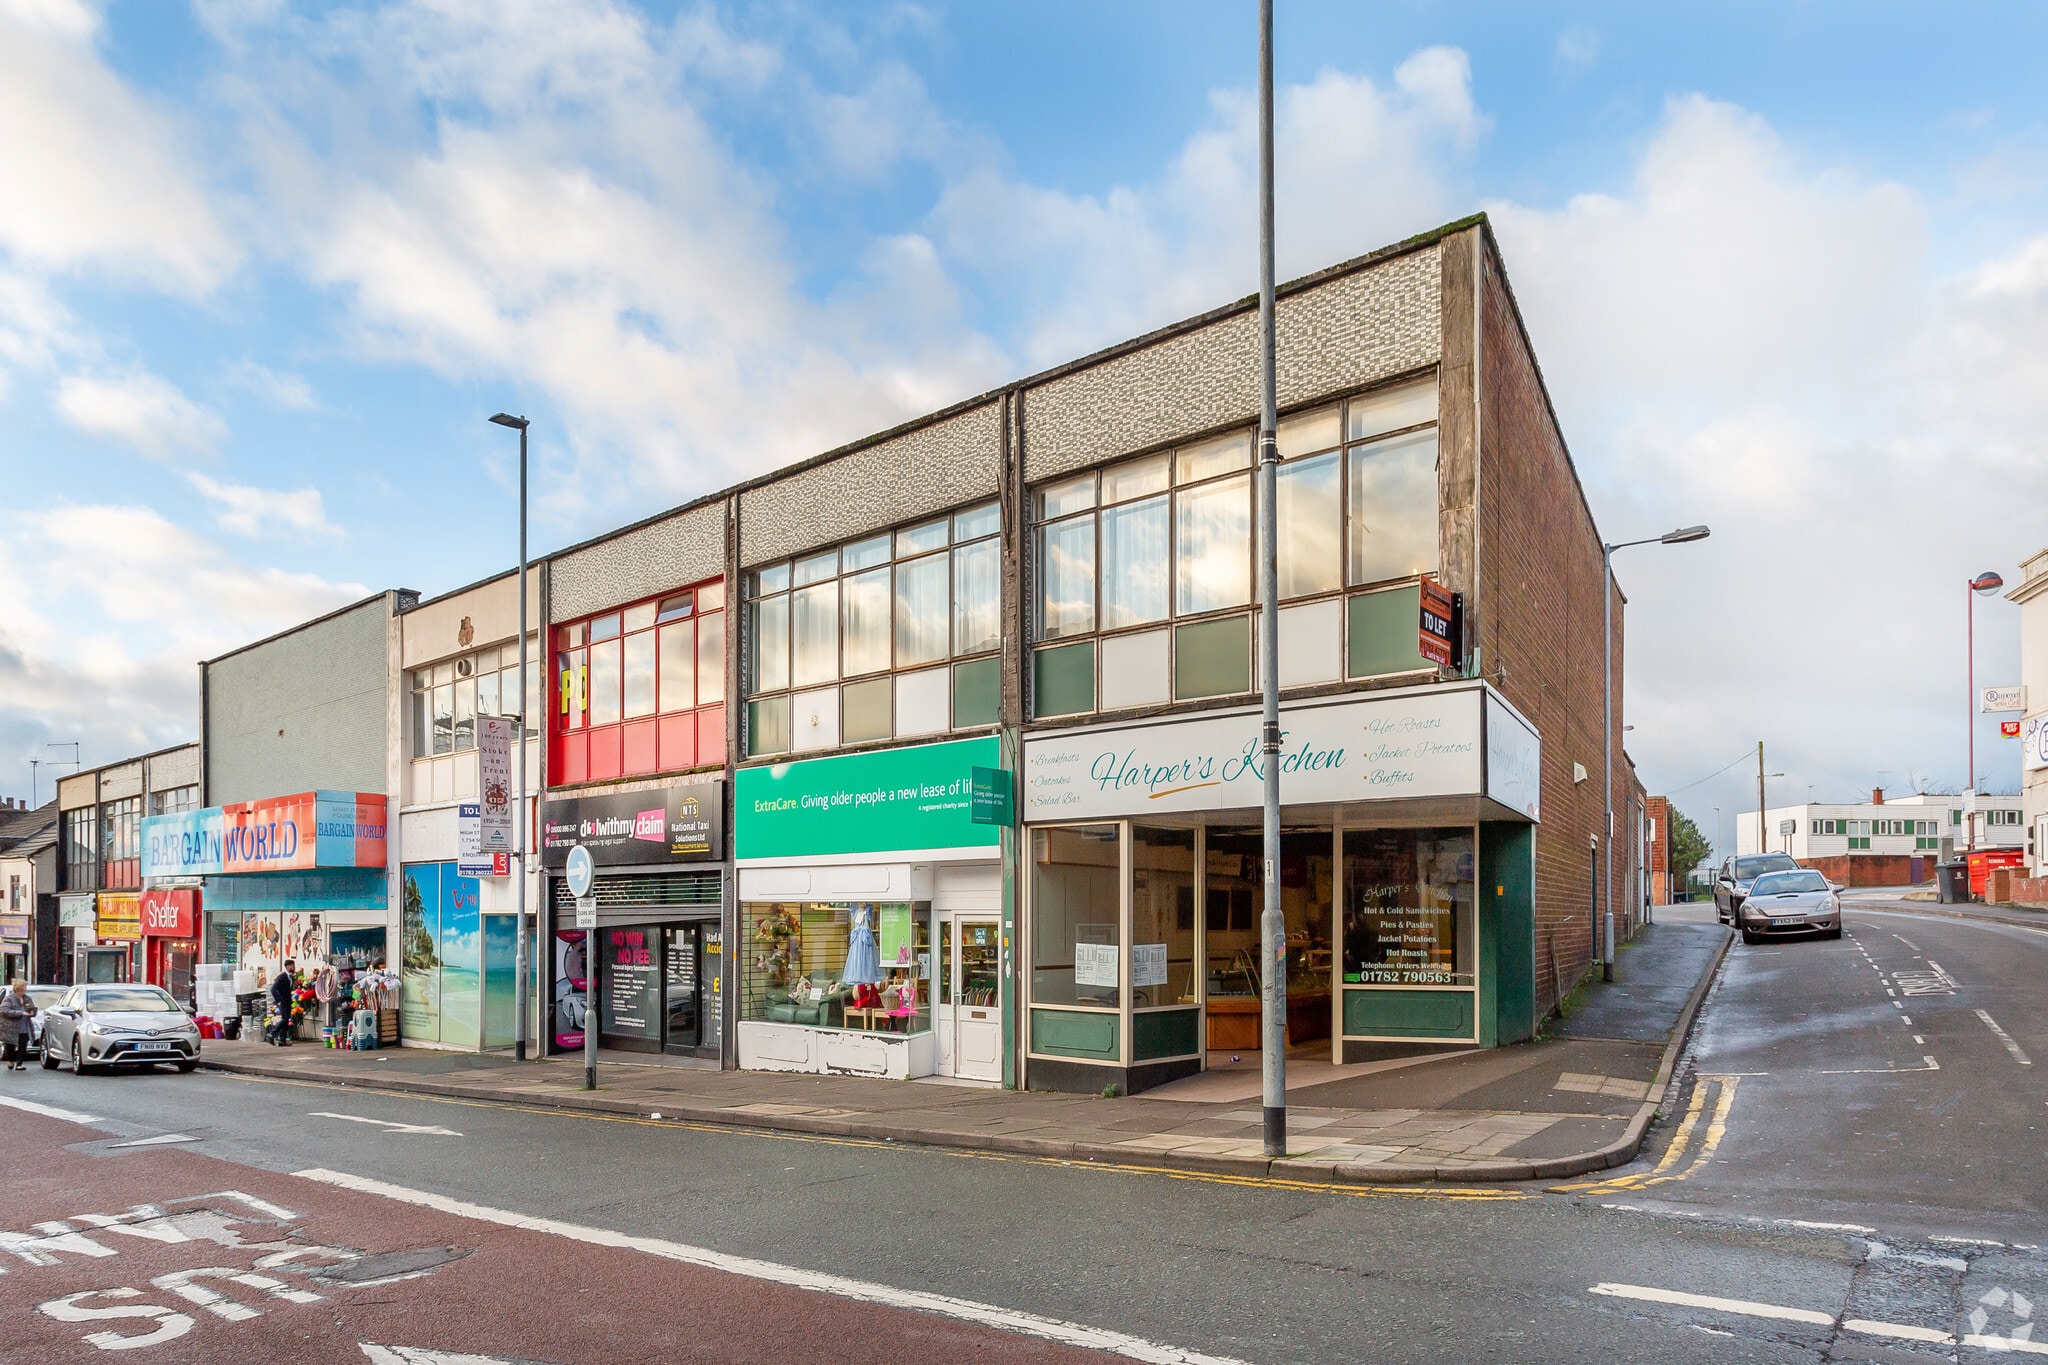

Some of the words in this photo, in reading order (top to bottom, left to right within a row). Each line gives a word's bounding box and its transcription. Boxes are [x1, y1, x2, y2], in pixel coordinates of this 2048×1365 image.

[1424, 612, 1434, 631] TO
[1434, 617, 1447, 637] LET
[1369, 717, 1395, 735] Hot
[1397, 716, 1441, 733] Roasts
[482, 746, 508, 755] Stoke
[1369, 744, 1410, 763] Jacket
[1414, 741, 1473, 759] Potatoes
[1033, 752, 1080, 767] Breakfasts
[1091, 748, 1216, 793] Harper's
[1222, 731, 1347, 782] Kchen
[483, 766, 509, 775] Trent
[1034, 774, 1071, 787] Oatcakes
[1369, 769, 1416, 787] Buffets
[801, 793, 829, 811] Giving
[830, 790, 854, 806] older
[855, 787, 886, 809] people
[888, 790, 895, 801] a
[897, 787, 918, 800] new
[920, 783, 945, 798] lease
[948, 778, 960, 795] of
[962, 778, 972, 794] lif
[974, 790, 985, 798] Giving
[1034, 794, 1061, 807] Salad
[1062, 792, 1082, 804] Bar
[464, 807, 475, 815] TO
[682, 804, 697, 816] NTS
[922, 803, 942, 812] registered
[943, 802, 957, 811] charity
[318, 822, 355, 838] BARGAIN
[356, 823, 385, 839] WORLD
[671, 821, 696, 832] National
[697, 820, 710, 830] Taxi
[150, 828, 221, 867] BARGAIN
[223, 820, 298, 862] WORLD
[675, 833, 697, 843] Solutions
[698, 832, 706, 842] Ltd
[1363, 881, 1410, 902] Harper's
[466, 894, 477, 905] TUI
[580, 900, 592, 908] Except
[149, 899, 179, 928] Shelter
[1364, 906, 1378, 914] Hot
[1386, 906, 1404, 914] Cold
[1405, 906, 1450, 915] Sandwiches
[1405, 921, 1434, 929] Pasties
[611, 931, 624, 946] NO
[625, 931, 644, 946] WIN
[706, 932, 717, 942] Had
[1377, 935, 1401, 943] Jacket
[1403, 935, 1437, 943] Potatoes
[617, 949, 631, 964] NO
[633, 948, 650, 965] FEE
[1386, 949, 1400, 957] Hot
[1401, 949, 1428, 957] Roasts
[1361, 961, 1395, 970] Telephone
[1420, 962, 1450, 970] Welco
[1360, 971, 1399, 982] 01782
[1402, 971, 1452, 983] 790563
